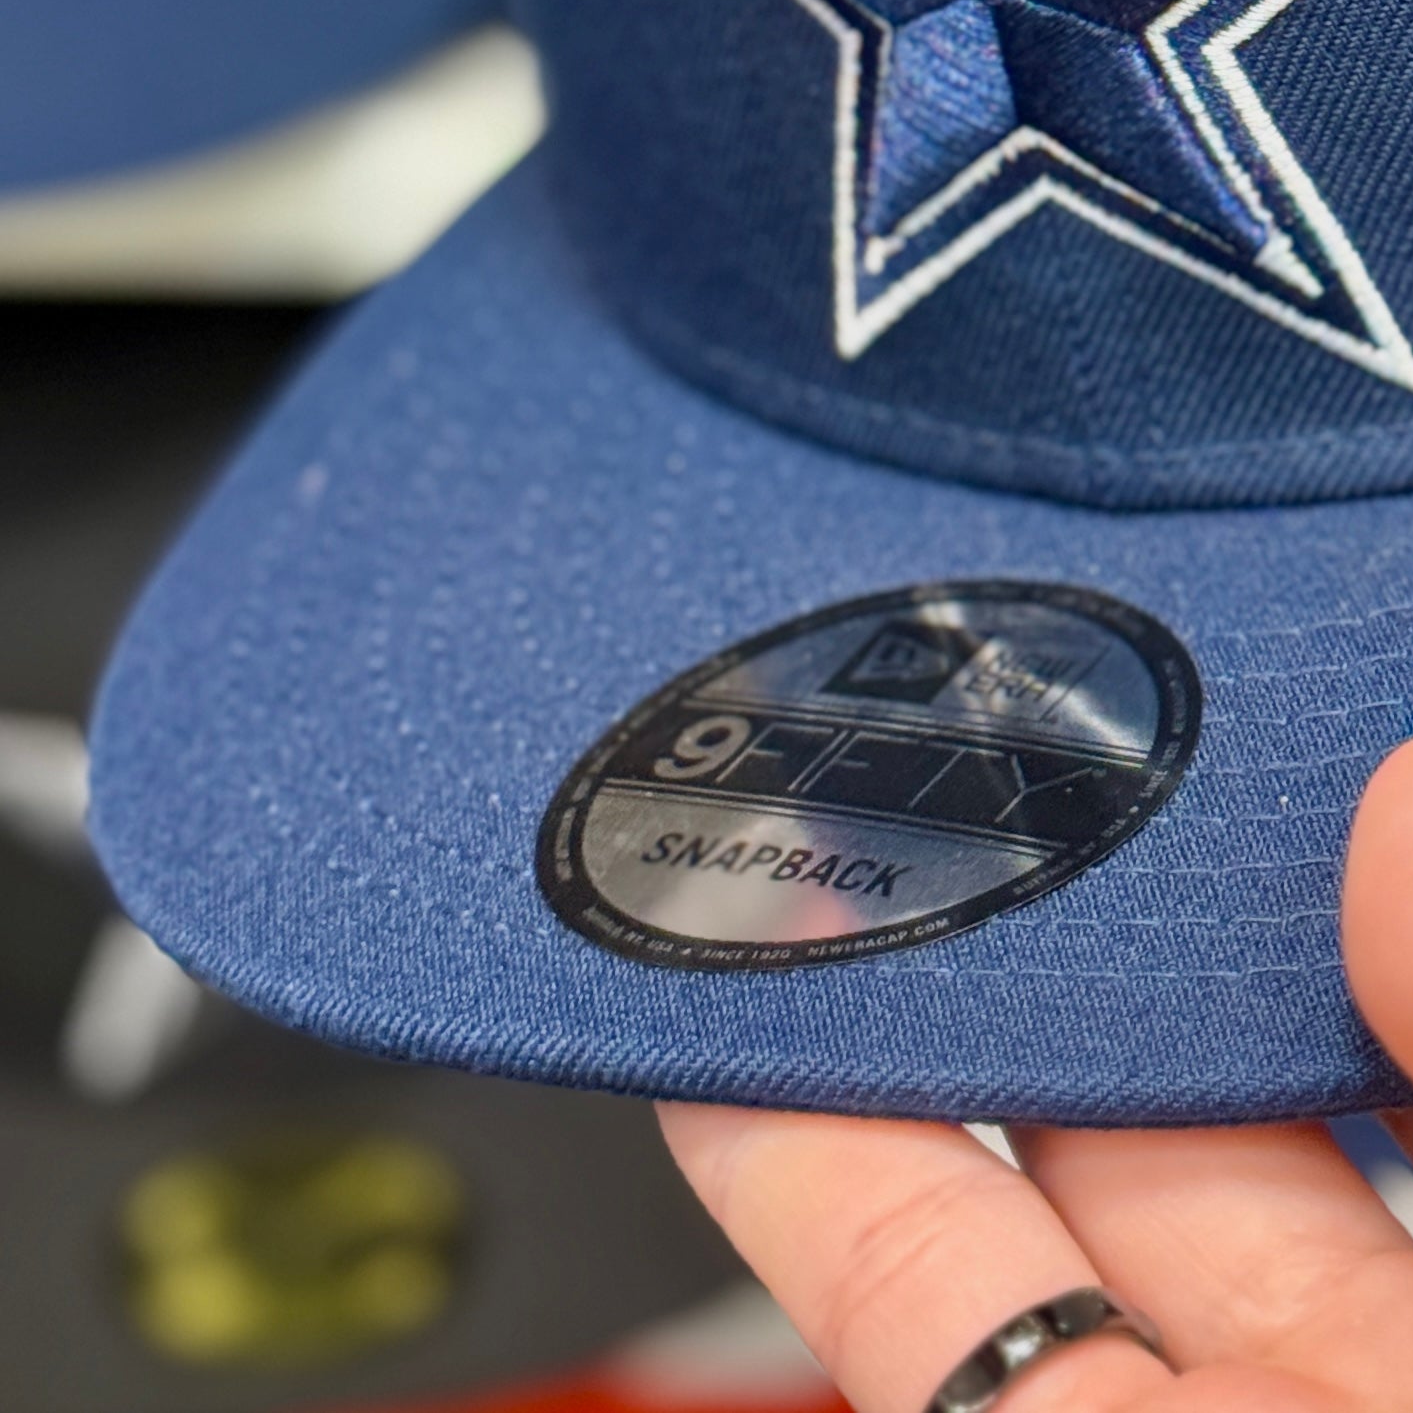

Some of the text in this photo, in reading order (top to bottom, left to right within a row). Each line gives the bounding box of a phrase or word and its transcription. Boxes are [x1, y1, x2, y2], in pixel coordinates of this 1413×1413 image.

[653, 715, 1094, 824] 9FIFTY
[642, 832, 911, 898] SNAPBACK
[647, 939, 675, 954] USA
[702, 948, 744, 960] SINCE
